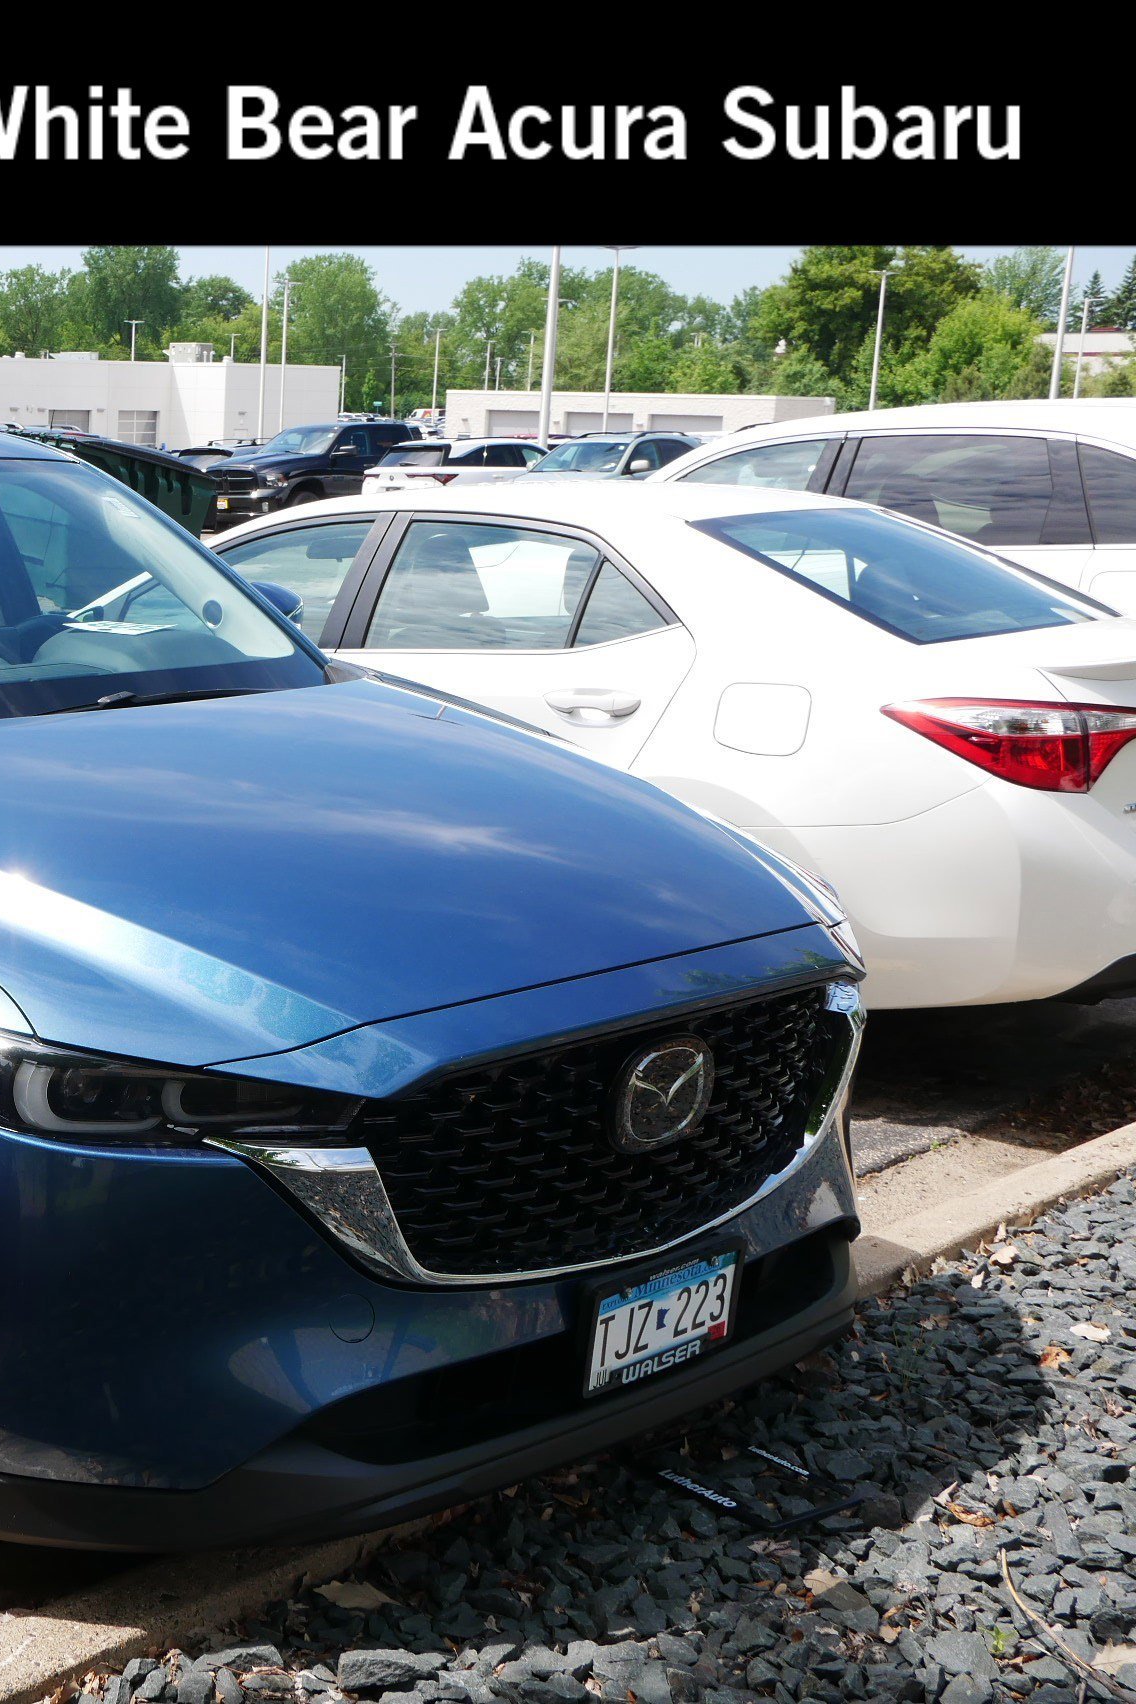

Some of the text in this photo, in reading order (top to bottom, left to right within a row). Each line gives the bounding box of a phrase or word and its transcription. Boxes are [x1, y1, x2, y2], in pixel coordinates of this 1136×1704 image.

[599, 1273, 728, 1368] TJZ 223
[621, 1339, 702, 1385] WALSER
[658, 1469, 737, 1508] LutherAuto
